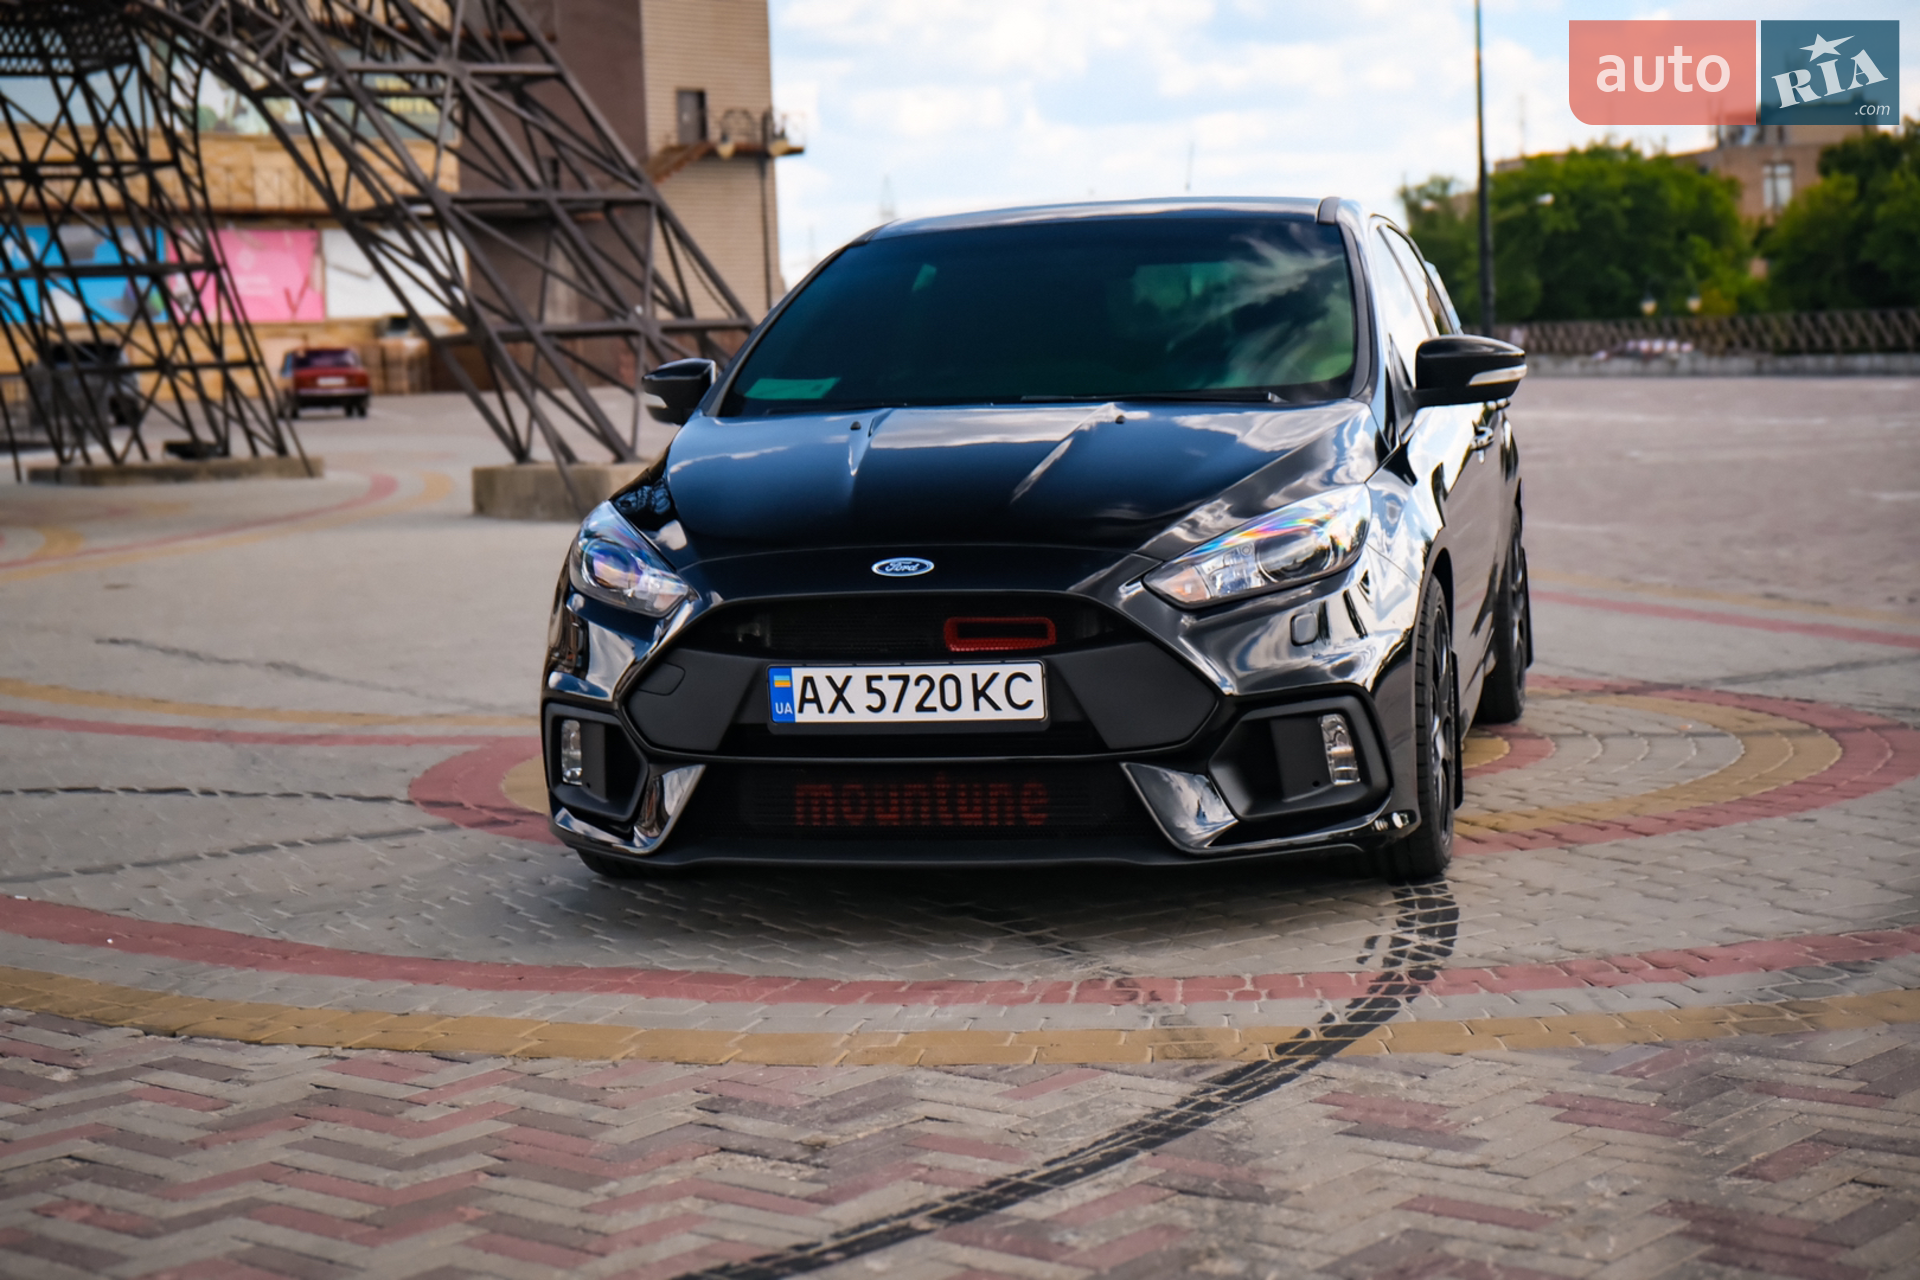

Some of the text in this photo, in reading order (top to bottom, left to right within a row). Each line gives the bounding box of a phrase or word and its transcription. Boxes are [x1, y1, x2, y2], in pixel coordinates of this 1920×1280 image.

[884, 561, 920, 572] Ford
[797, 671, 1035, 714] AX 5720 KC
[775, 702, 793, 715] UA
[795, 772, 1050, 826] mountune
